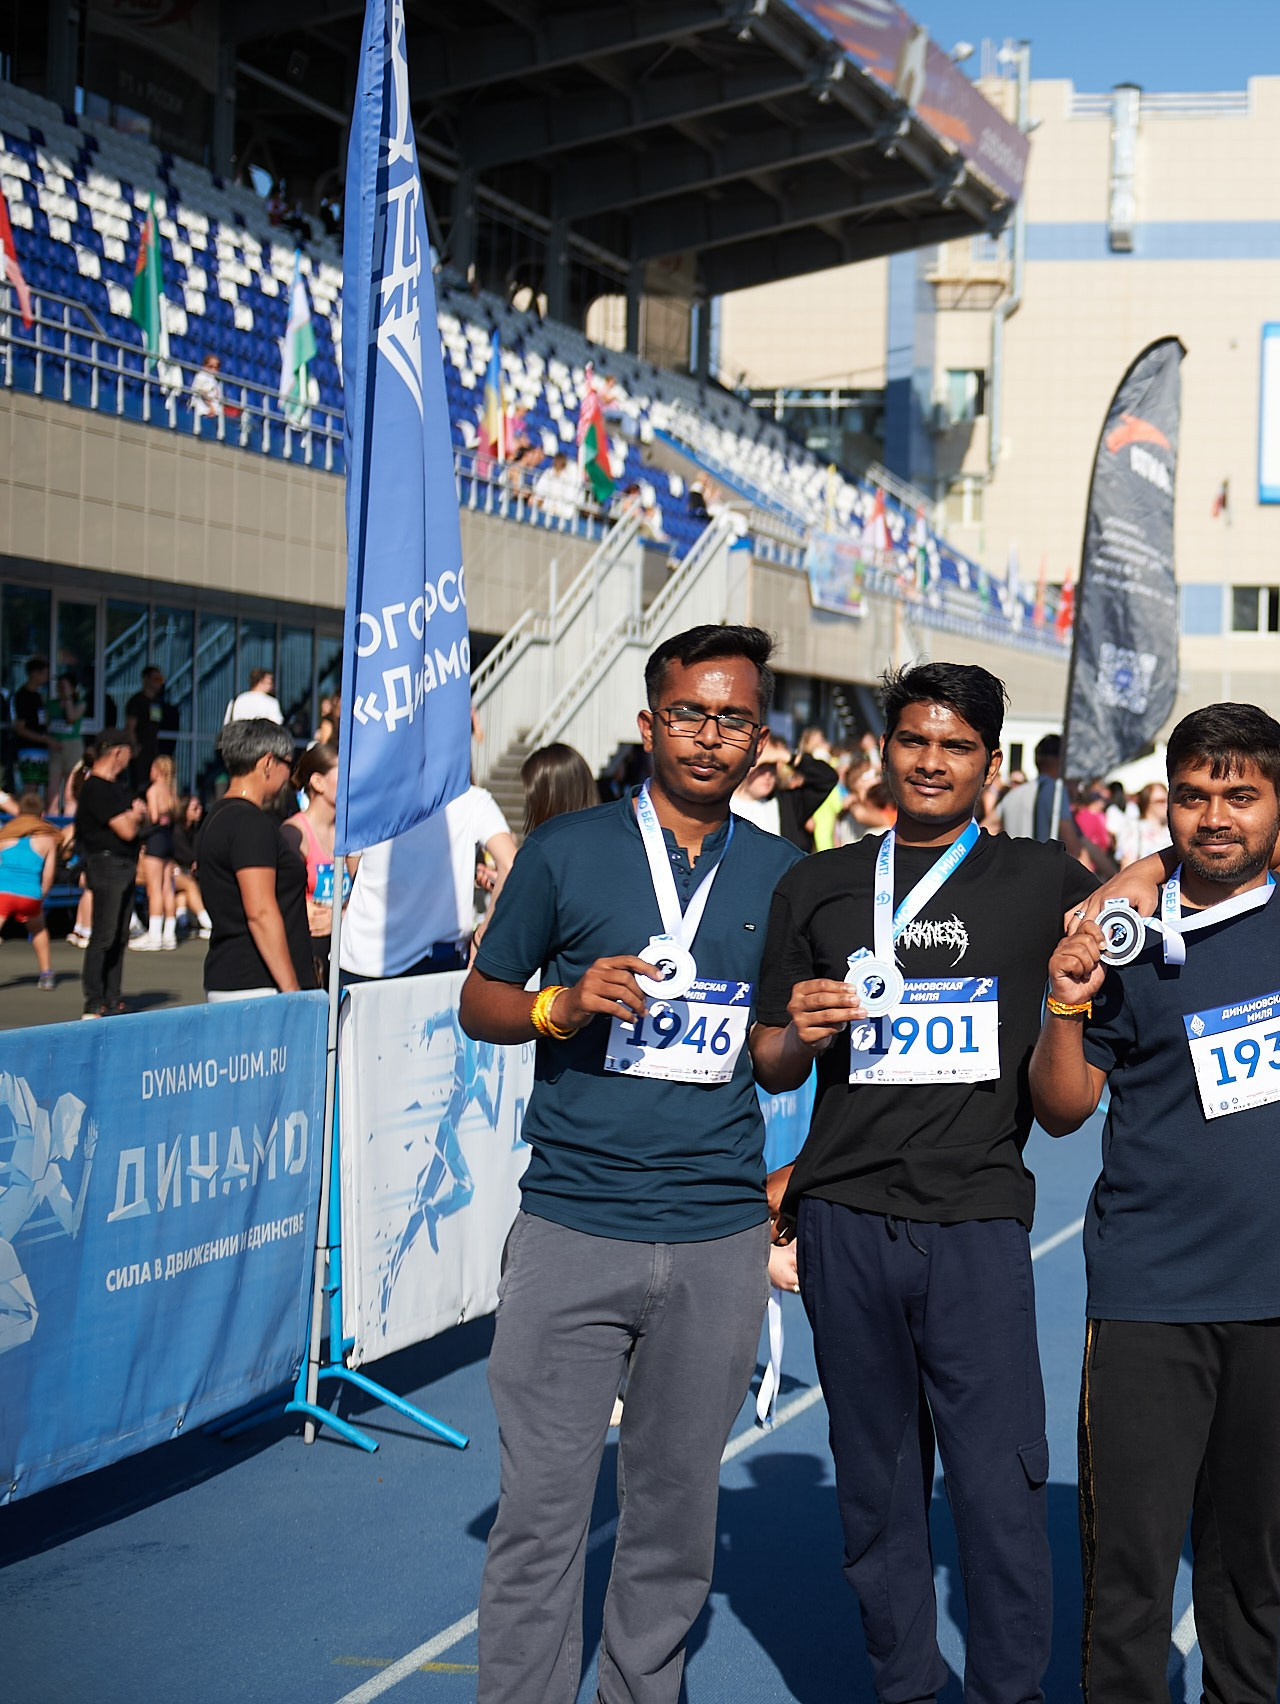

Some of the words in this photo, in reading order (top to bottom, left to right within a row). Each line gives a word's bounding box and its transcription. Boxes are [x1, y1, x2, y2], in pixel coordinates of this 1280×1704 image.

[894, 913, 970, 960] ARKNESS
[690, 980, 727, 993] ОВСКАЯ
[910, 993, 940, 1001] МИЛЯ
[626, 1010, 731, 1056] 1946
[869, 1016, 979, 1055] 1901
[1247, 1008, 1273, 1023] МИЛЯ
[142, 1045, 288, 1100] DYNAMO-UDM.RU
[106, 1109, 309, 1223] ДИНАМО
[105, 1261, 152, 1292] СИЛА
[154, 1260, 163, 1281] В
[164, 1234, 239, 1281] ДВИЖЕНИИ
[247, 1212, 304, 1246] ЕДИНСТВЕ
